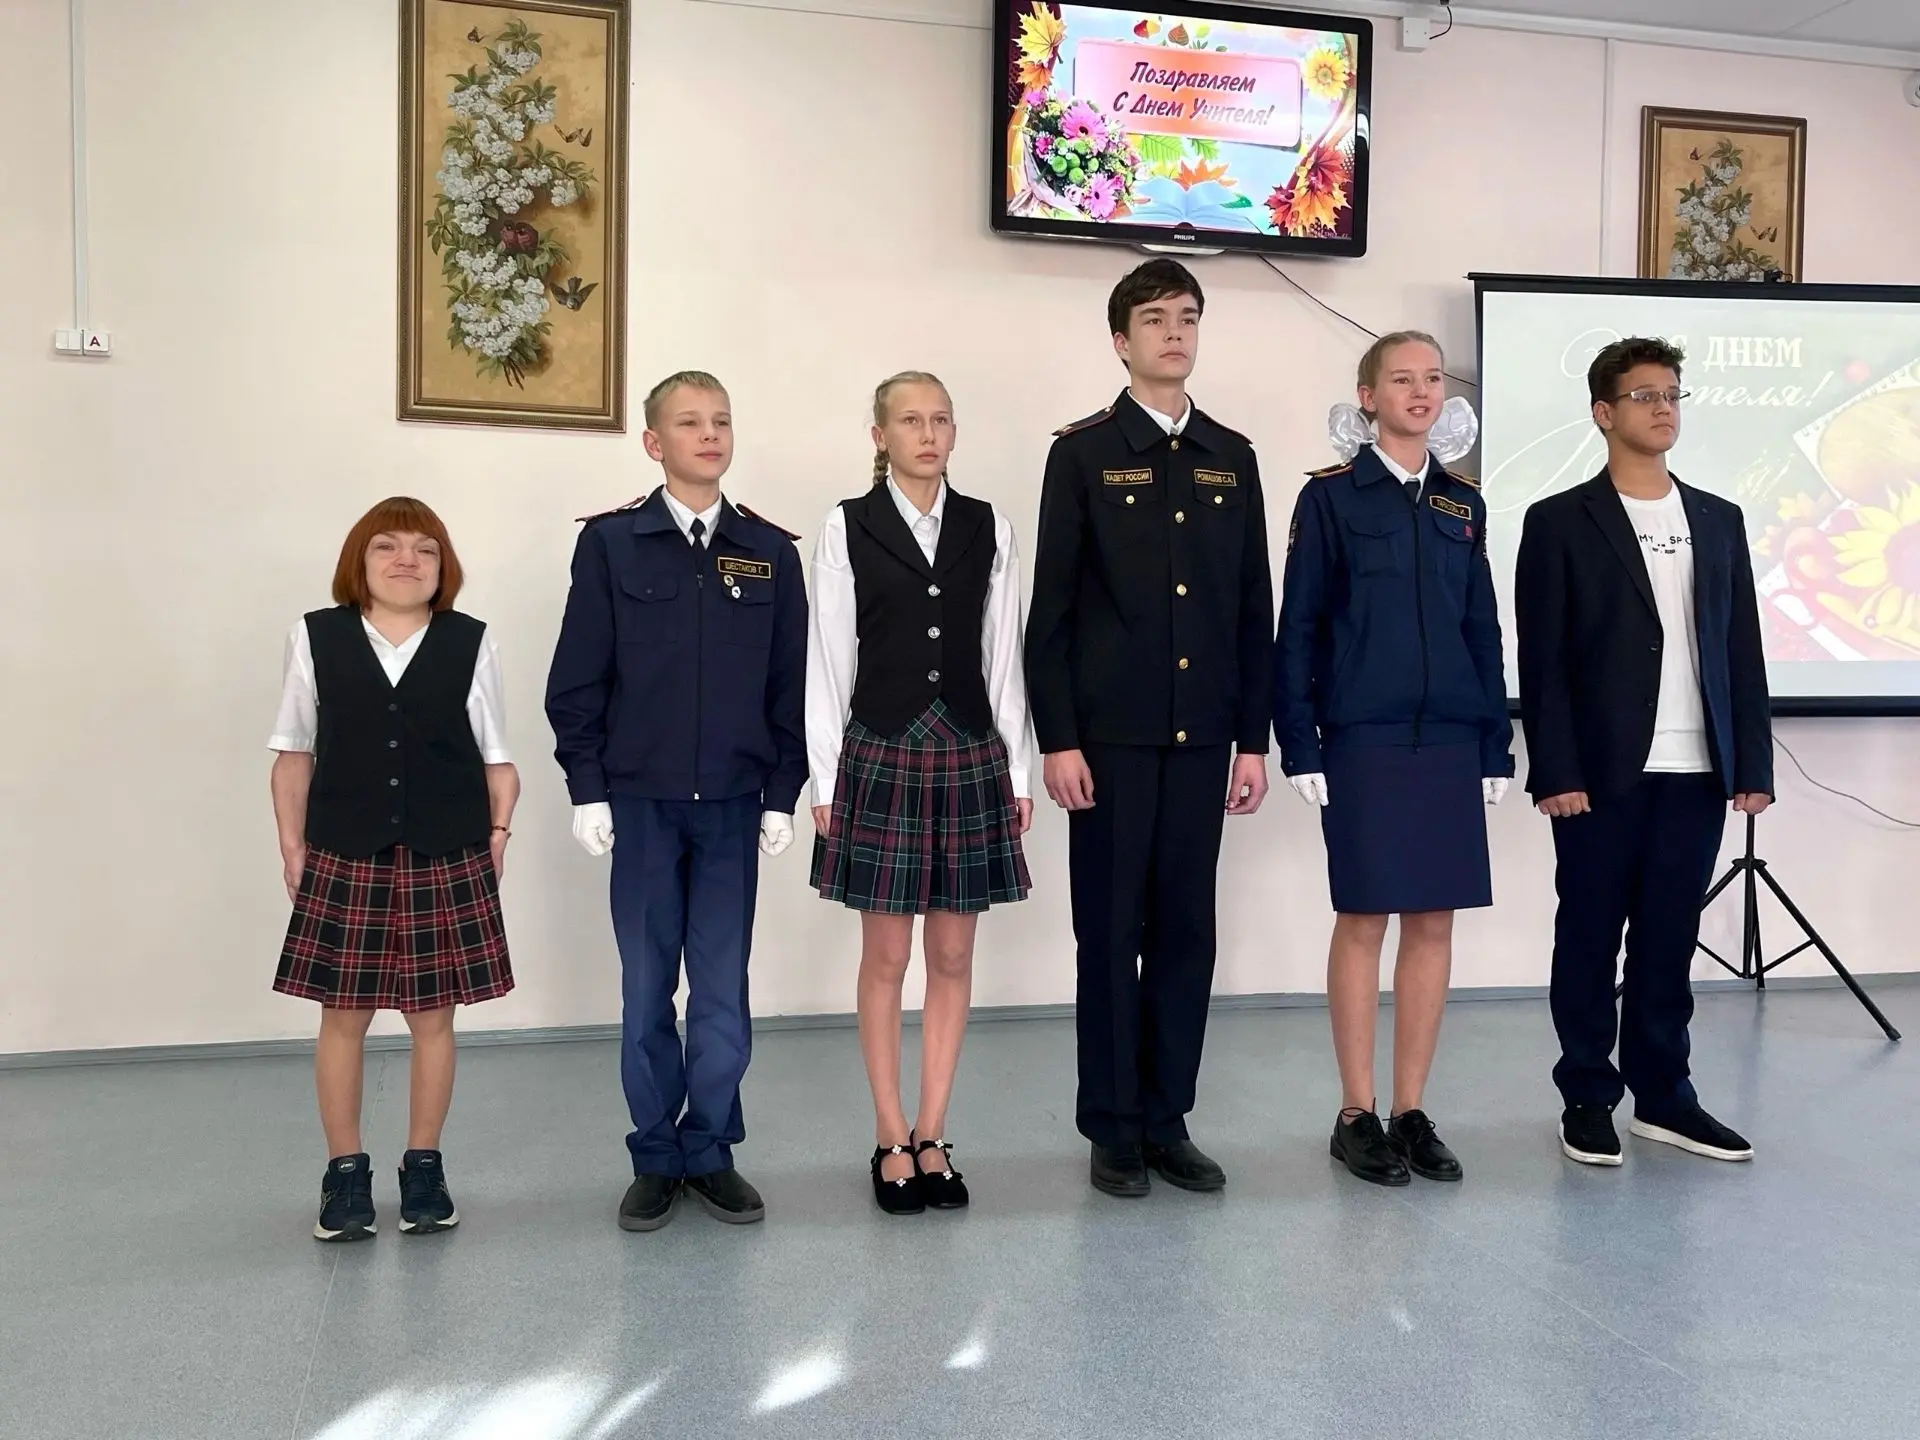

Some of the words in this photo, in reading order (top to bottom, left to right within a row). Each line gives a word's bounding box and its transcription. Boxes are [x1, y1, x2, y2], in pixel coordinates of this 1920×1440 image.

[1130, 61, 1257, 93] Поздравляем
[1113, 91, 1129, 112] С
[1130, 93, 1183, 118] Днем
[1189, 98, 1275, 126] Учителя!
[1173, 233, 1196, 241] PHILIPS
[1702, 336, 1802, 372] ДНЕМ
